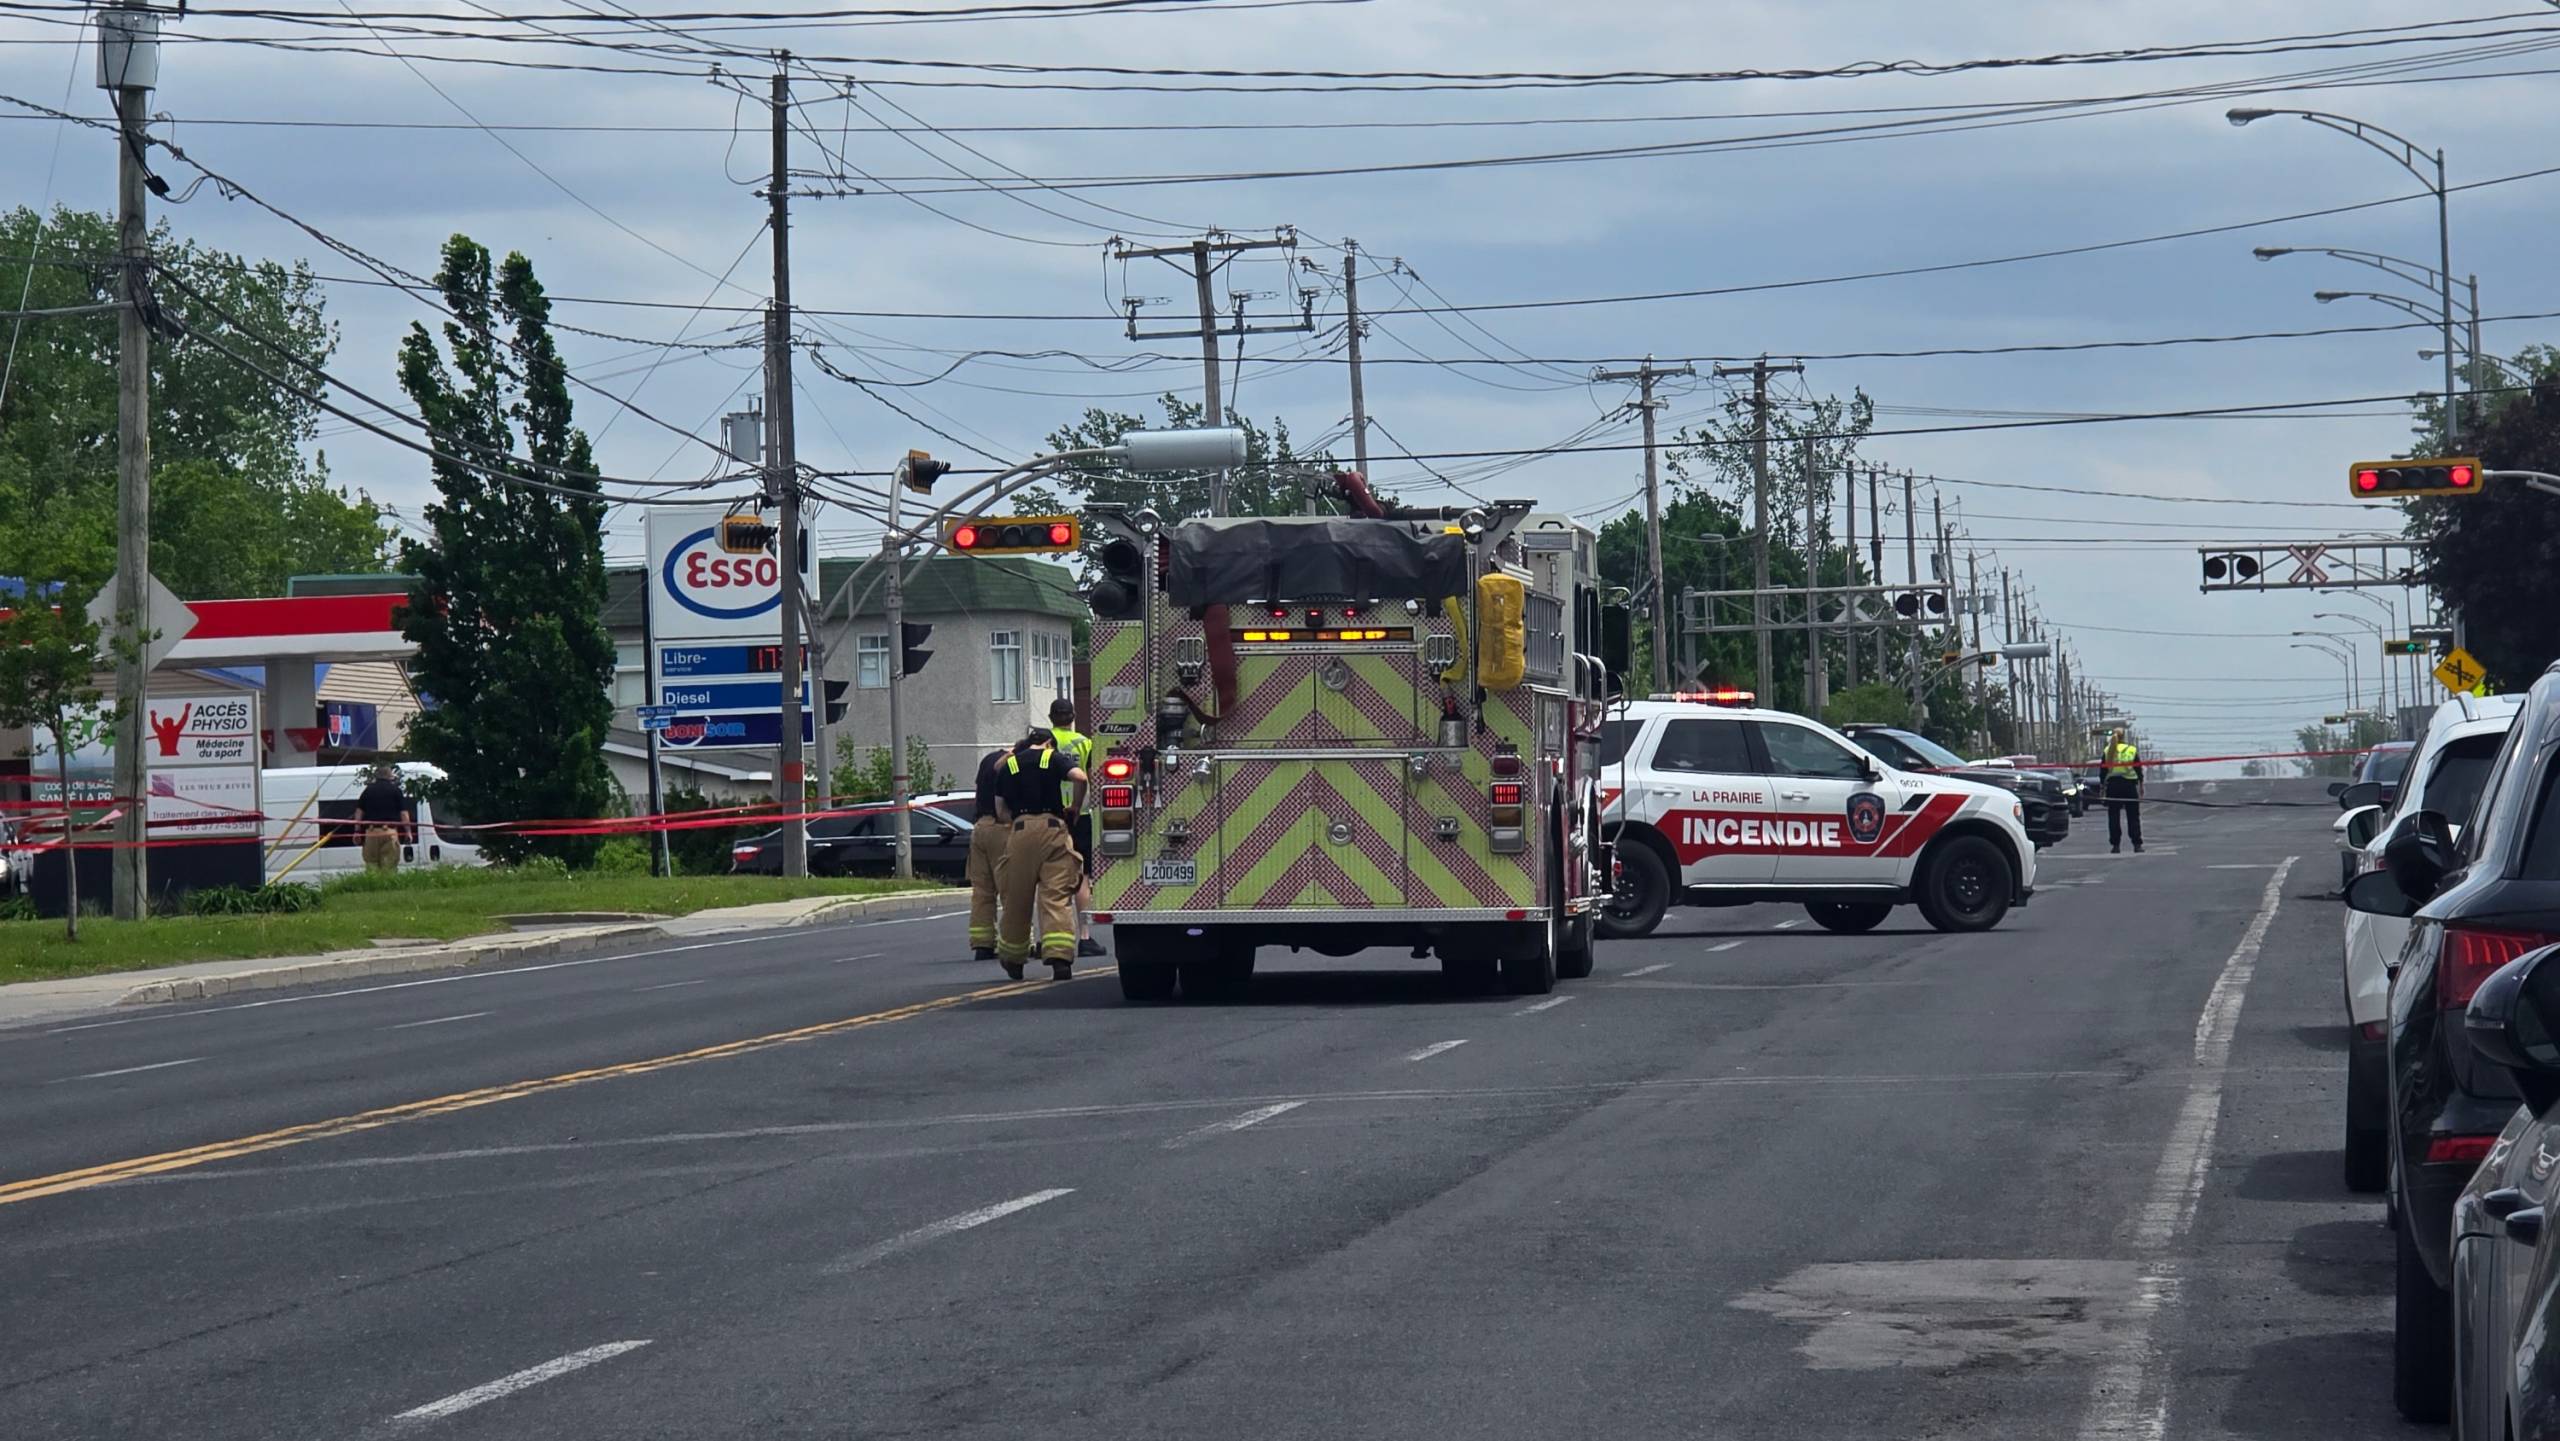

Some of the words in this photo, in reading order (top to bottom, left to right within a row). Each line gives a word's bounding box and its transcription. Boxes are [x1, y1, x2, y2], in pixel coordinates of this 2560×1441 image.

[664, 652, 707, 665] Libre-
[665, 690, 711, 704] Diesel
[1101, 689, 1131, 705] 227
[194, 701, 248, 717] ACCÈS
[191, 717, 248, 731] PHYSIO
[195, 739, 244, 749] Médecine
[199, 749, 212, 758] du
[215, 748, 241, 760] sport
[1692, 790, 1709, 803] LA
[1713, 791, 1763, 804] PRAIRIE
[1682, 817, 1842, 848] INCENDIE
[1144, 865, 1194, 880] L200499
